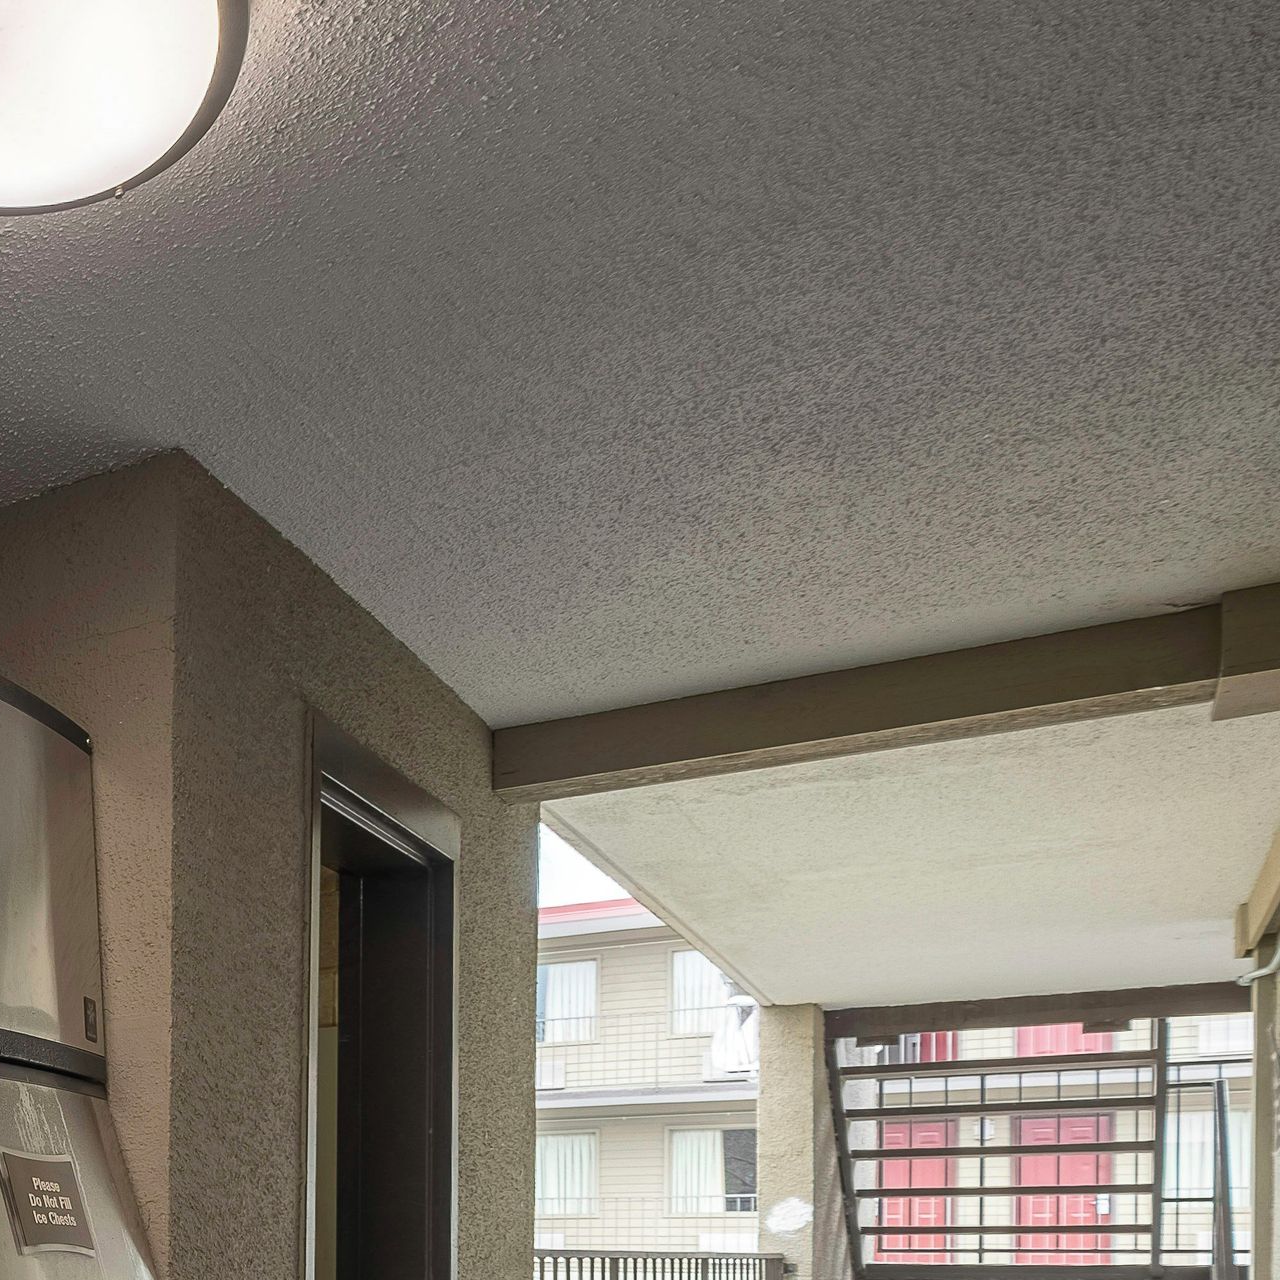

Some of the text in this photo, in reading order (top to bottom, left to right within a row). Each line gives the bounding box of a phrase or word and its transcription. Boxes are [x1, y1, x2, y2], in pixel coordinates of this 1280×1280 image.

[32, 1176, 60, 1192] Please
[28, 1193, 72, 1210] Do Not Fill
[32, 1210, 77, 1227] Ice Chests
